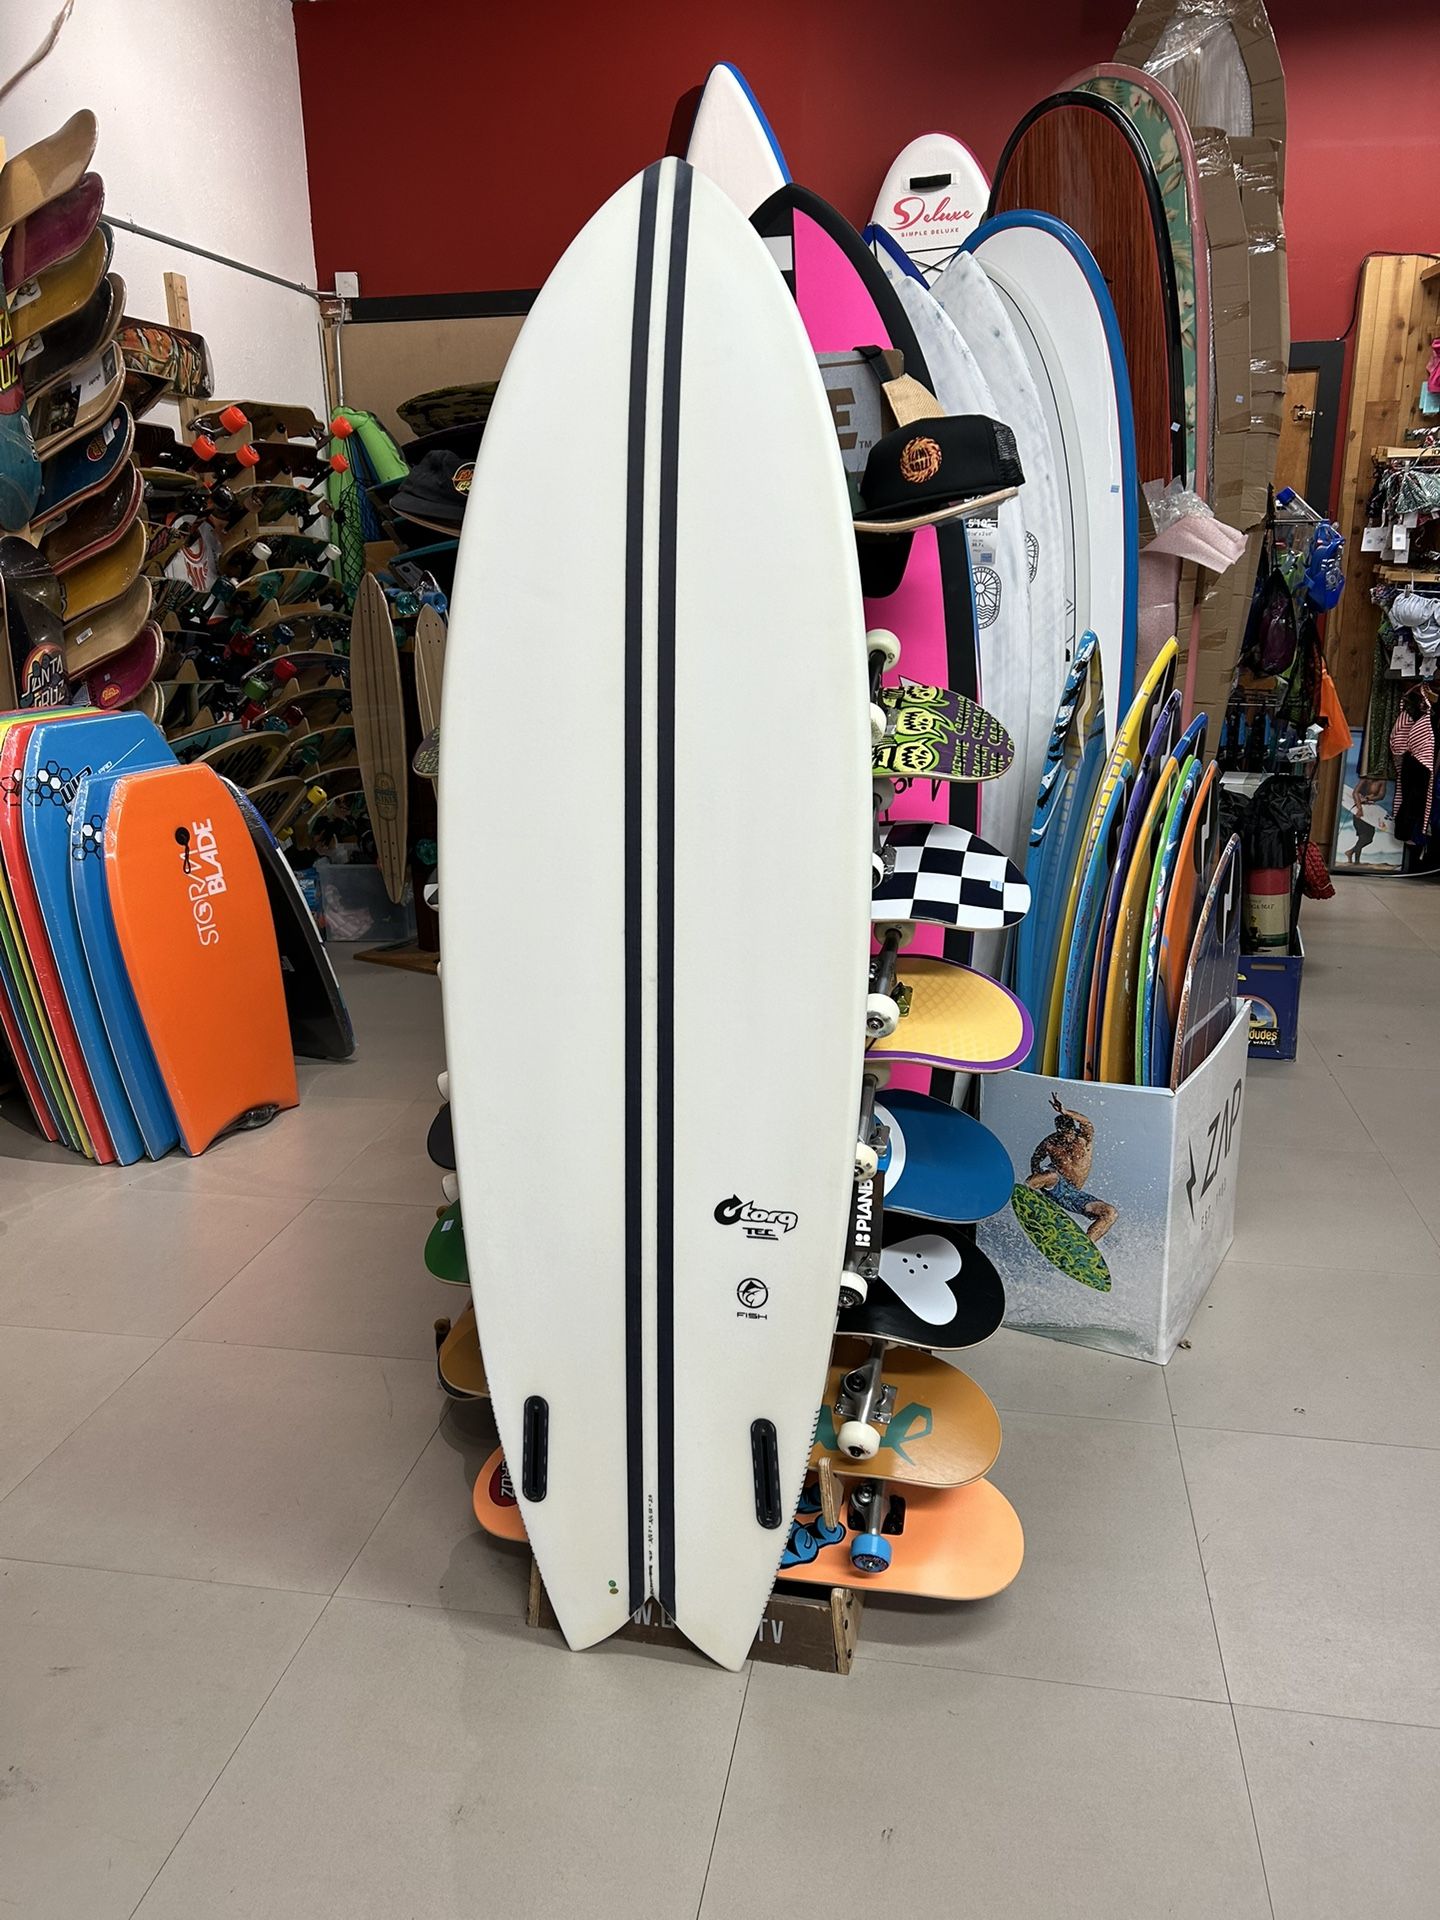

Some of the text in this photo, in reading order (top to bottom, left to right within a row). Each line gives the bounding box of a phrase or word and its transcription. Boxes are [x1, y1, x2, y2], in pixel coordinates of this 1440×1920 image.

[888, 196, 974, 230] Deluxe
[930, 227, 959, 235] DELUXE
[192, 818, 227, 896] BLADE
[179, 849, 220, 946] STORM
[1249, 1028, 1279, 1041] dudes
[1200, 1078, 1242, 1199] ZAP
[731, 1199, 798, 1234] torq
[742, 1226, 776, 1237] TEC
[736, 1311, 768, 1320] FISH
